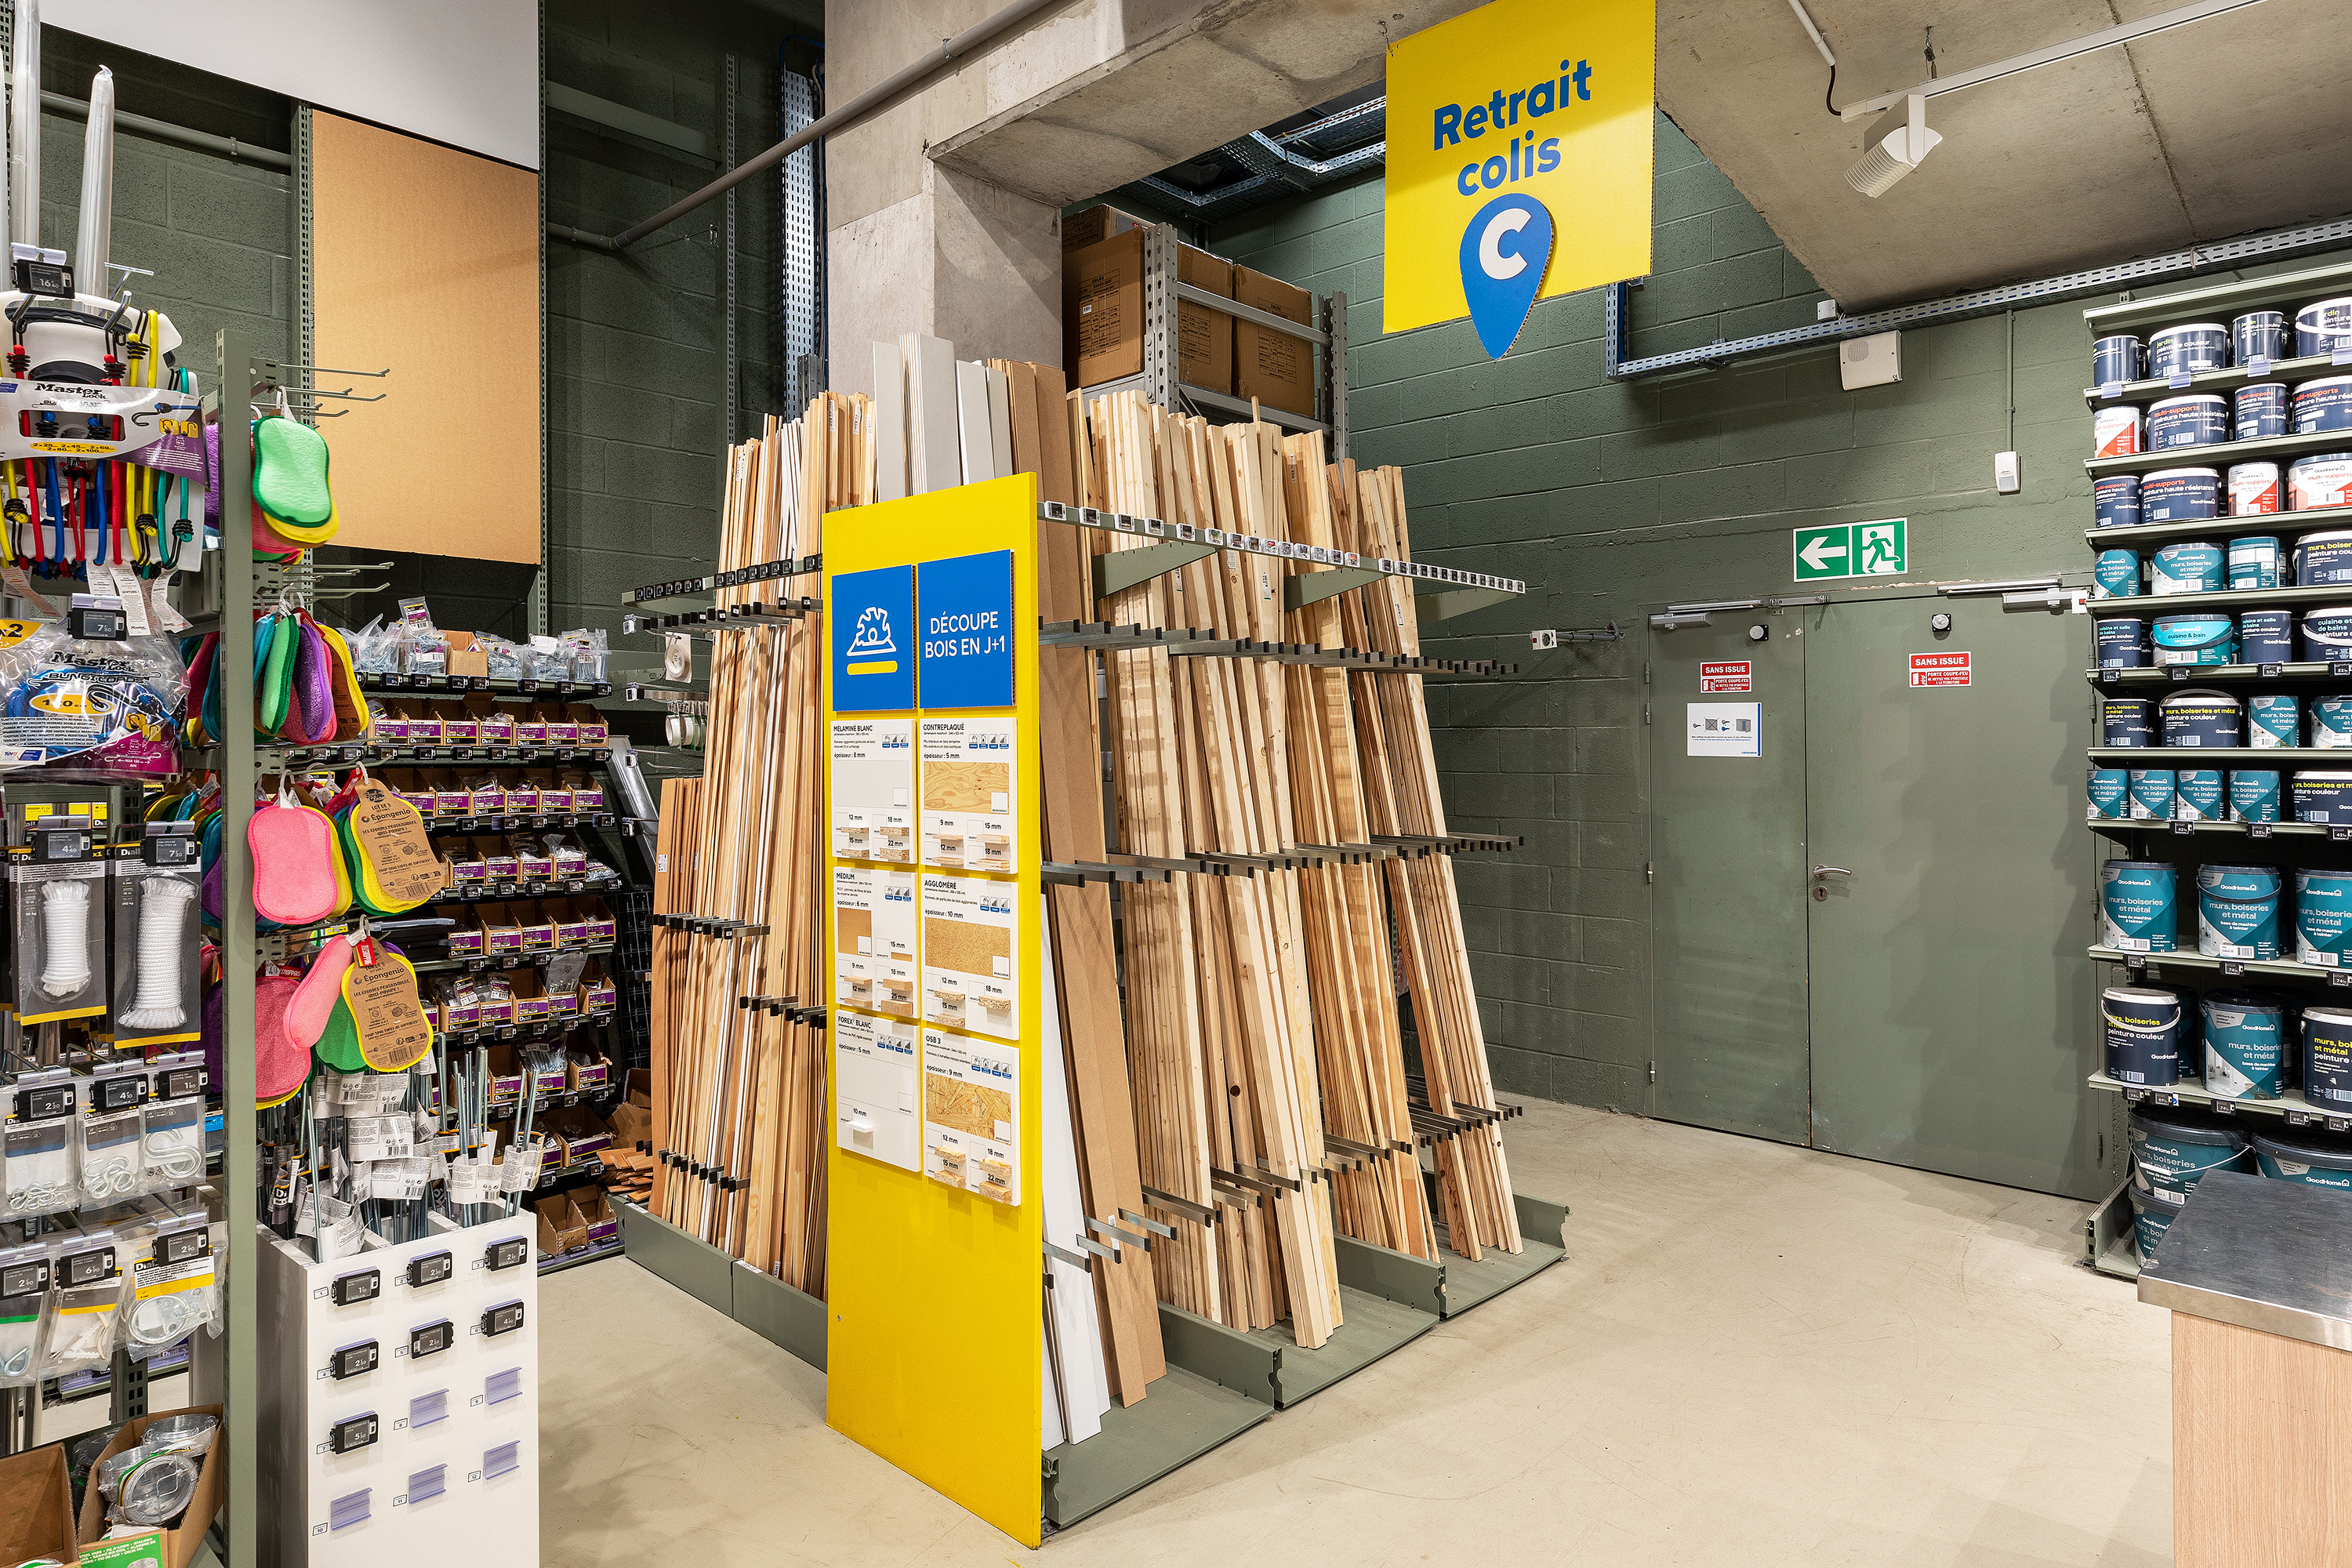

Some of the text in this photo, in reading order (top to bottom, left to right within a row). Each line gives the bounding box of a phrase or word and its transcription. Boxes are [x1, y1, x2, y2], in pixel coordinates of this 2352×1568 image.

[1433, 59, 1592, 151] Retrait
[1457, 129, 1562, 197] colis
[1479, 208, 1532, 281] C
[34, 383, 102, 395] Master
[2143, 479, 2185, 490] multi-supports
[2143, 488, 2164, 498] peinture
[930, 611, 999, 635] DÉCOUPE
[925, 635, 1005, 659] BOIS EN J+1
[1915, 657, 1965, 666] SANS ISSUE
[833, 724, 856, 732] MÉLAMINÉ
[370, 809, 411, 822] Épongenio
[121, 848, 140, 856] Diall
[924, 880, 956, 890] AGGLOMÉRÉ
[2127, 898, 2163, 906] boiseries
[2128, 905, 2151, 913] métal
[2232, 903, 2269, 912] boiseries
[2231, 912, 2257, 920] métal
[364, 967, 405, 982] Épongenio
[855, 1019, 872, 1029] BLANC
[926, 1035, 936, 1044] OSB
[839, 1043, 856, 1052] épaisseur
[2228, 1043, 2281, 1051] murs, boiseries
[2252, 1051, 2274, 1060] métal
[927, 1064, 946, 1075] épaisseur
[948, 1136, 959, 1145] mm
[994, 1150, 1004, 1159] mm
[949, 1161, 959, 1170] mm
[995, 1177, 1006, 1185] mm
[2305, 1176, 2340, 1186] GoodHome
